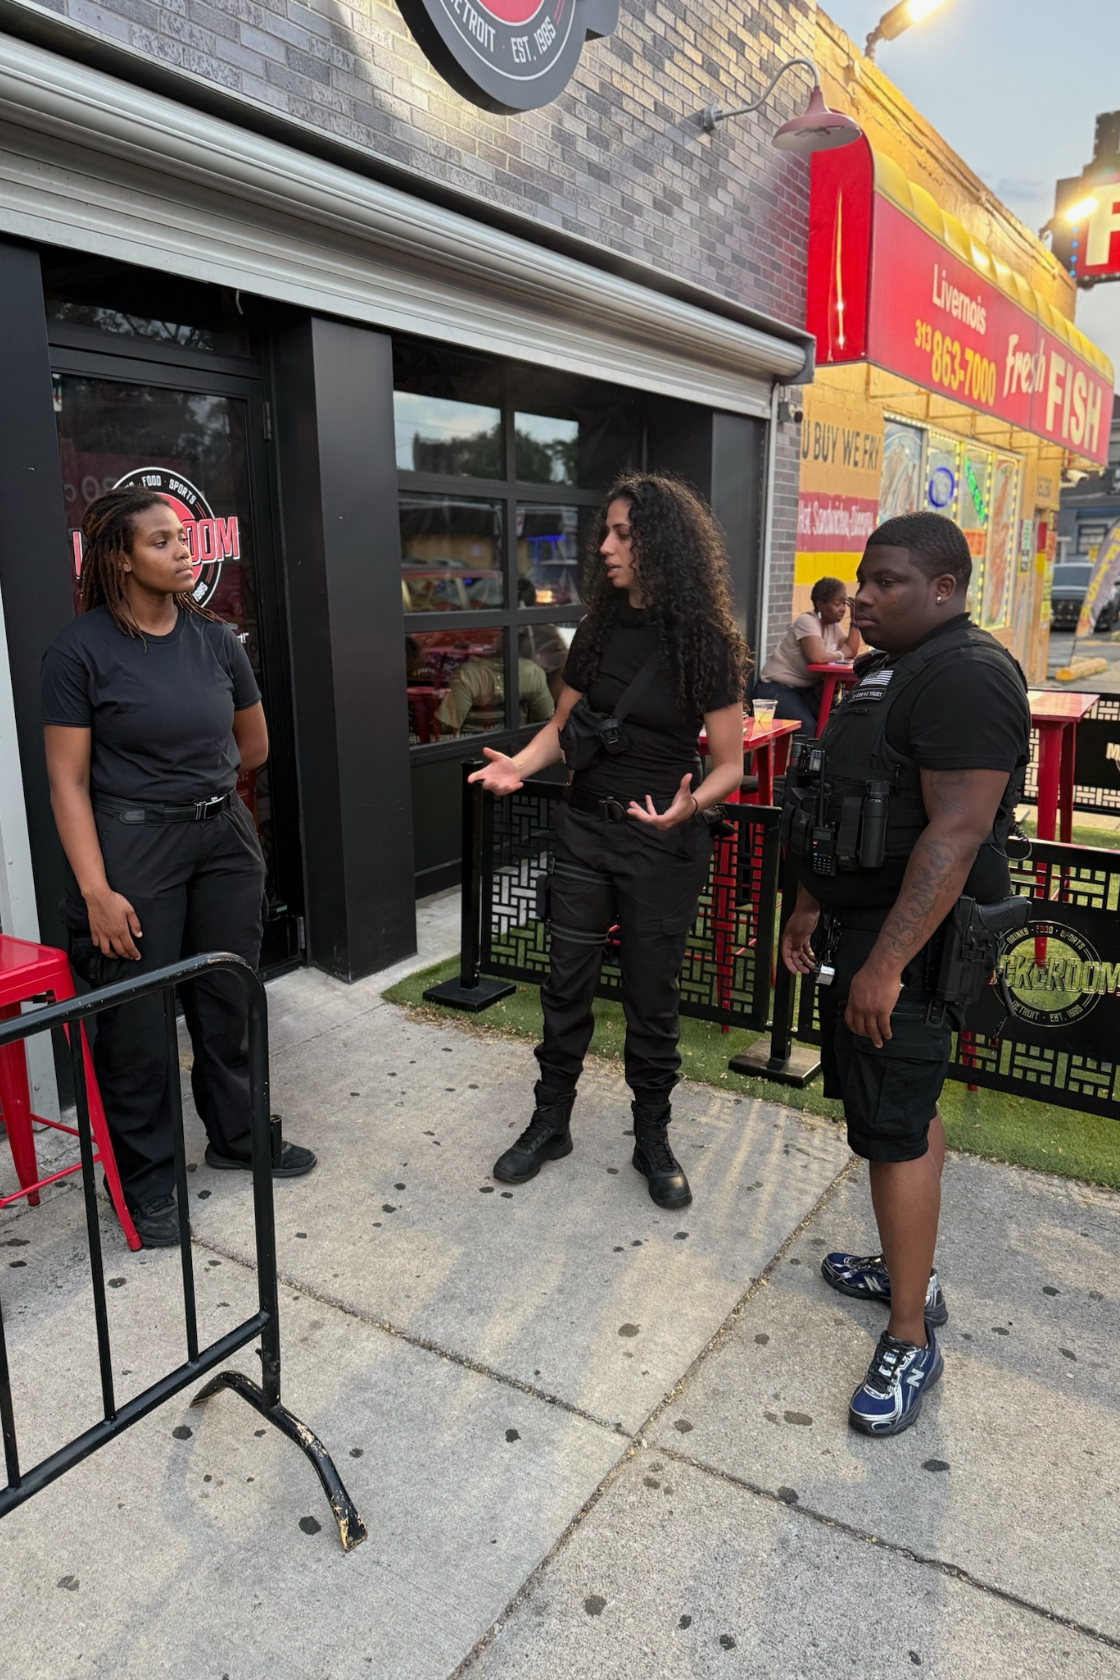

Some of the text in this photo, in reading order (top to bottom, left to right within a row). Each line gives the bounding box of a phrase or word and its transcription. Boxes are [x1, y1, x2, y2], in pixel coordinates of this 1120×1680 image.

[451, 0, 557, 63] ETROIT EST. 1985
[932, 263, 987, 336] Livernois
[914, 318, 997, 407] 313 863-7000
[1045, 350, 1103, 454] FISH
[813, 421, 840, 465] BUY
[842, 427, 861, 468] WE
[861, 432, 882, 471] FRY
[142, 475, 197, 506] FOOD SPORTS
[1006, 925, 1086, 950] DRINKS FOOD SPORTS
[996, 954, 1120, 996] CKEROOM
